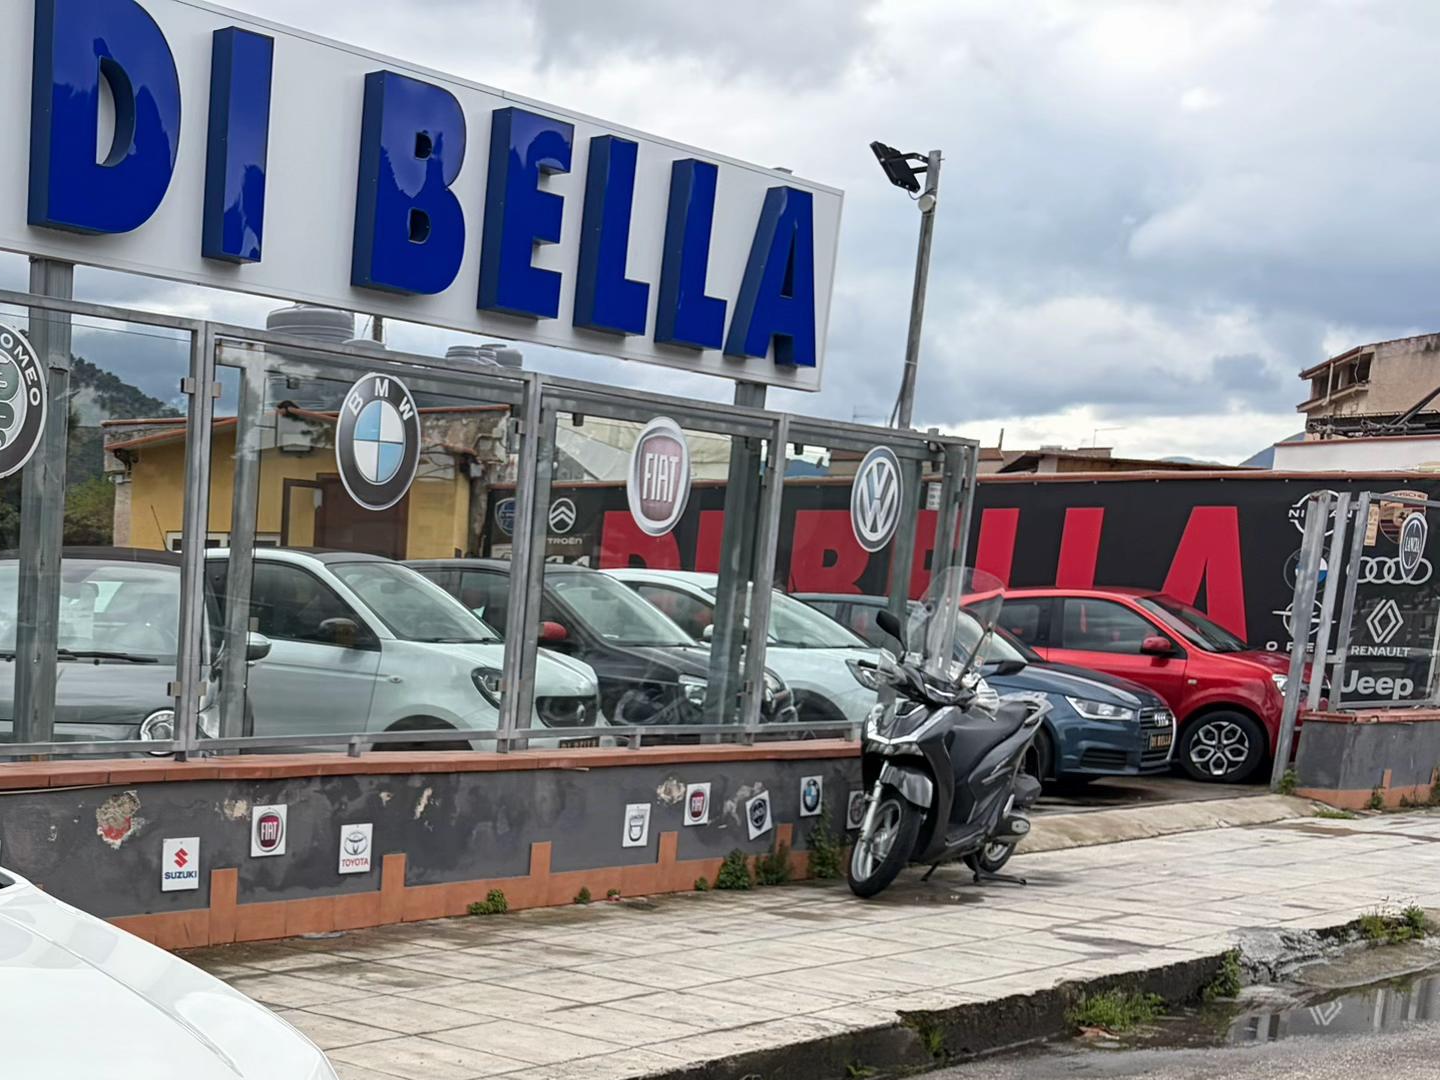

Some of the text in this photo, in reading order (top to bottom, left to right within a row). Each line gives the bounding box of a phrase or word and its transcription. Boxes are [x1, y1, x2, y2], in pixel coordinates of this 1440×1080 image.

[27, 0, 817, 368] DI BELLA
[348, 378, 414, 421] BMW
[642, 452, 680, 503] FIAT
[1350, 645, 1411, 658] RENAULT
[1340, 669, 1414, 700] Jeep
[261, 821, 278, 841] FIAT
[164, 871, 198, 880] SUZUKI
[341, 858, 369, 868] TOYOTA
